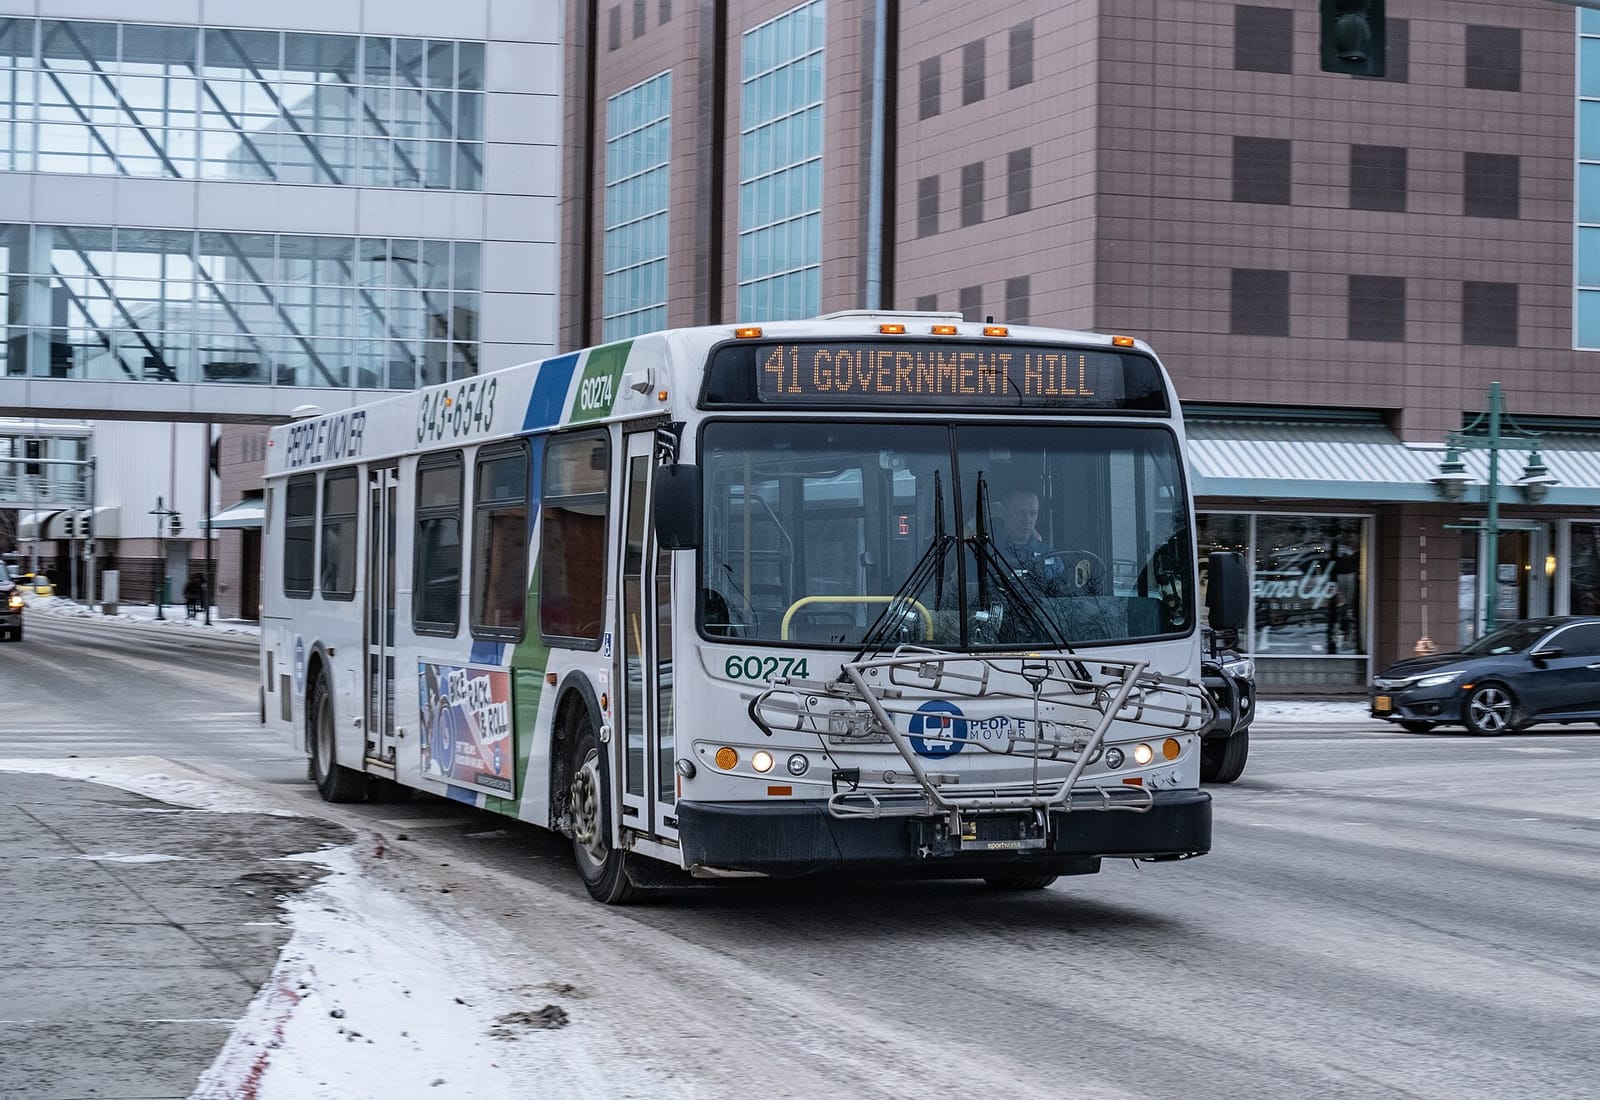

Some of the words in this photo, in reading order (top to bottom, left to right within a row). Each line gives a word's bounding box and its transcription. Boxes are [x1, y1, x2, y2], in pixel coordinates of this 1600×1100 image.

[580, 374, 613, 411] 60274
[764, 345, 802, 394] 41
[813, 349, 1013, 395] GOVERNMENT
[1024, 353, 1095, 396] HILL
[417, 377, 497, 444] 343-6543
[286, 420, 327, 469] PEOPLE
[326, 410, 366, 460] MOVER
[724, 655, 810, 681] 60274
[970, 729, 1026, 740] MOVER
